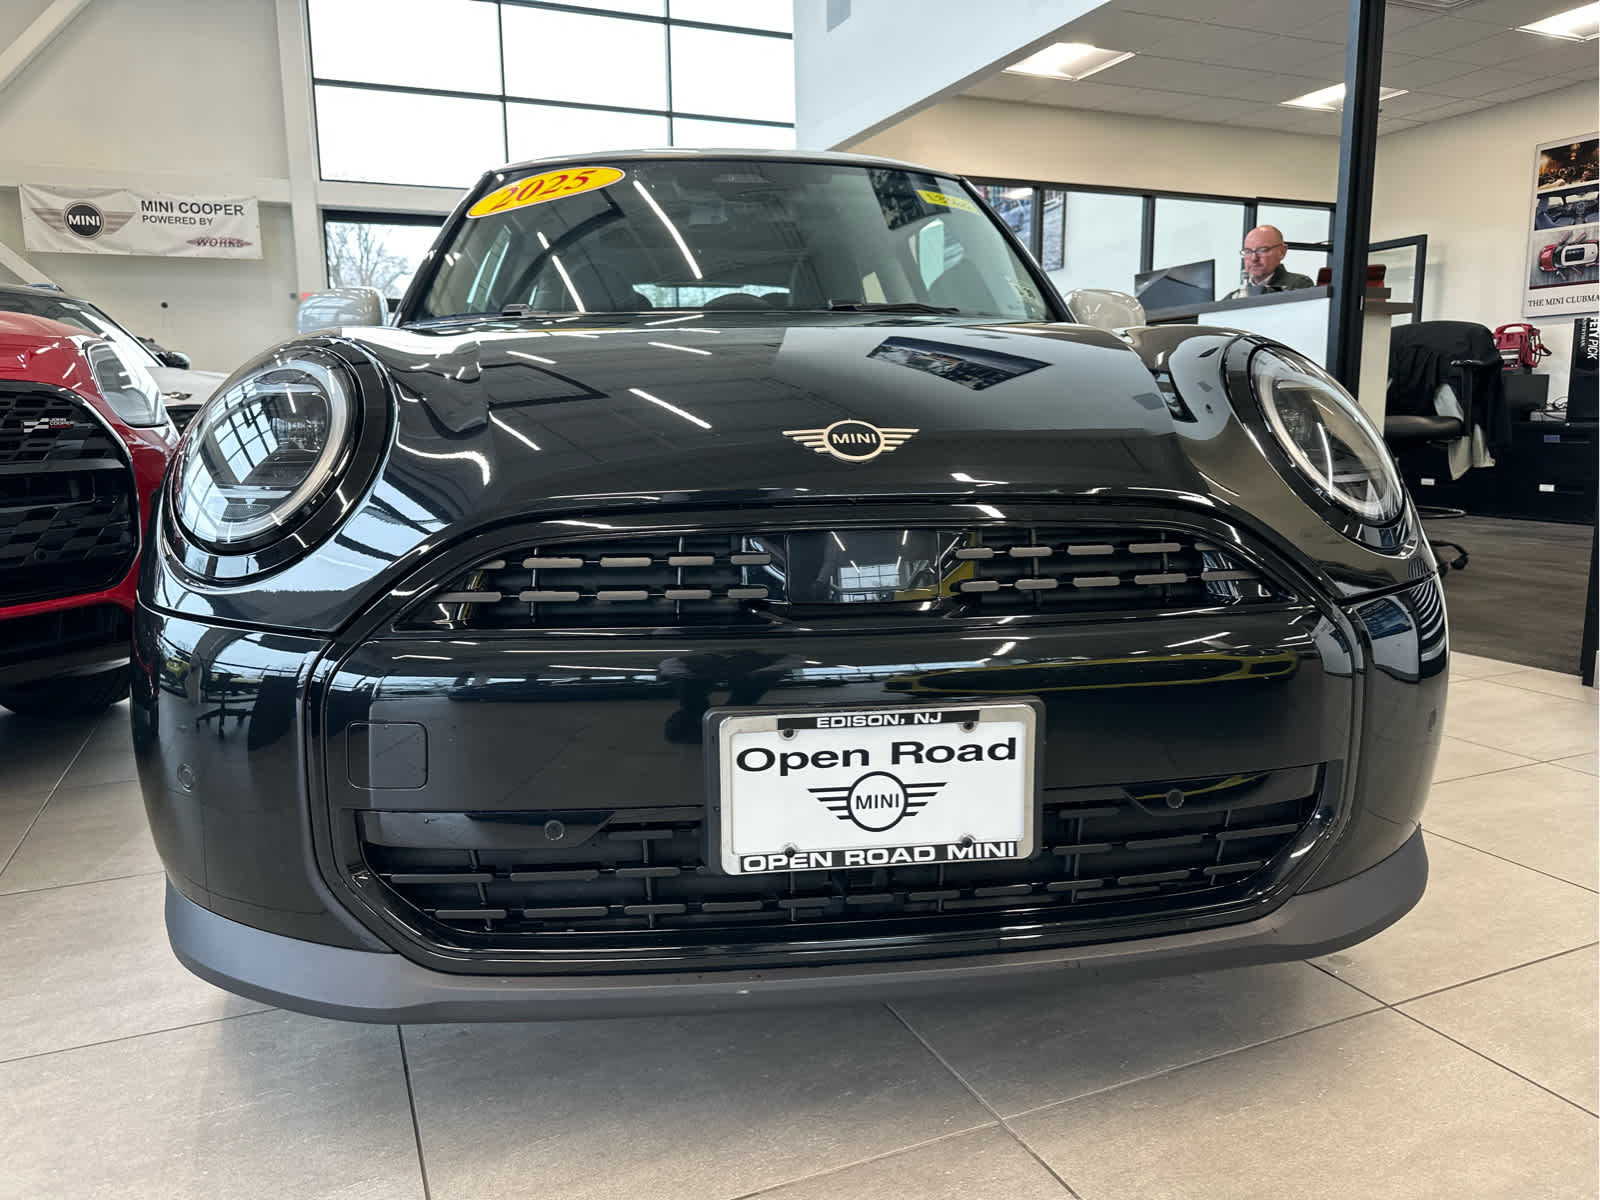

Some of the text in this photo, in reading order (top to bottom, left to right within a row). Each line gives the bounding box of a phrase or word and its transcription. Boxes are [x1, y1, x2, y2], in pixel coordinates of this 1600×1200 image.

[488, 170, 597, 212] 2025
[140, 200, 245, 216] MINI COOPER
[67, 214, 101, 226] MINI
[142, 215, 214, 227] POWERED BY
[197, 237, 244, 248] WORKS
[1528, 299, 1544, 307] THE
[1545, 297, 1564, 305] MINI
[1587, 338, 1599, 360] PICK
[831, 433, 877, 444] MINI
[816, 712, 942, 729] EDISON, NJ
[736, 737, 1017, 776] Open Road
[855, 793, 900, 810] MINI
[743, 842, 1015, 872] OPEN ROAD MINI
